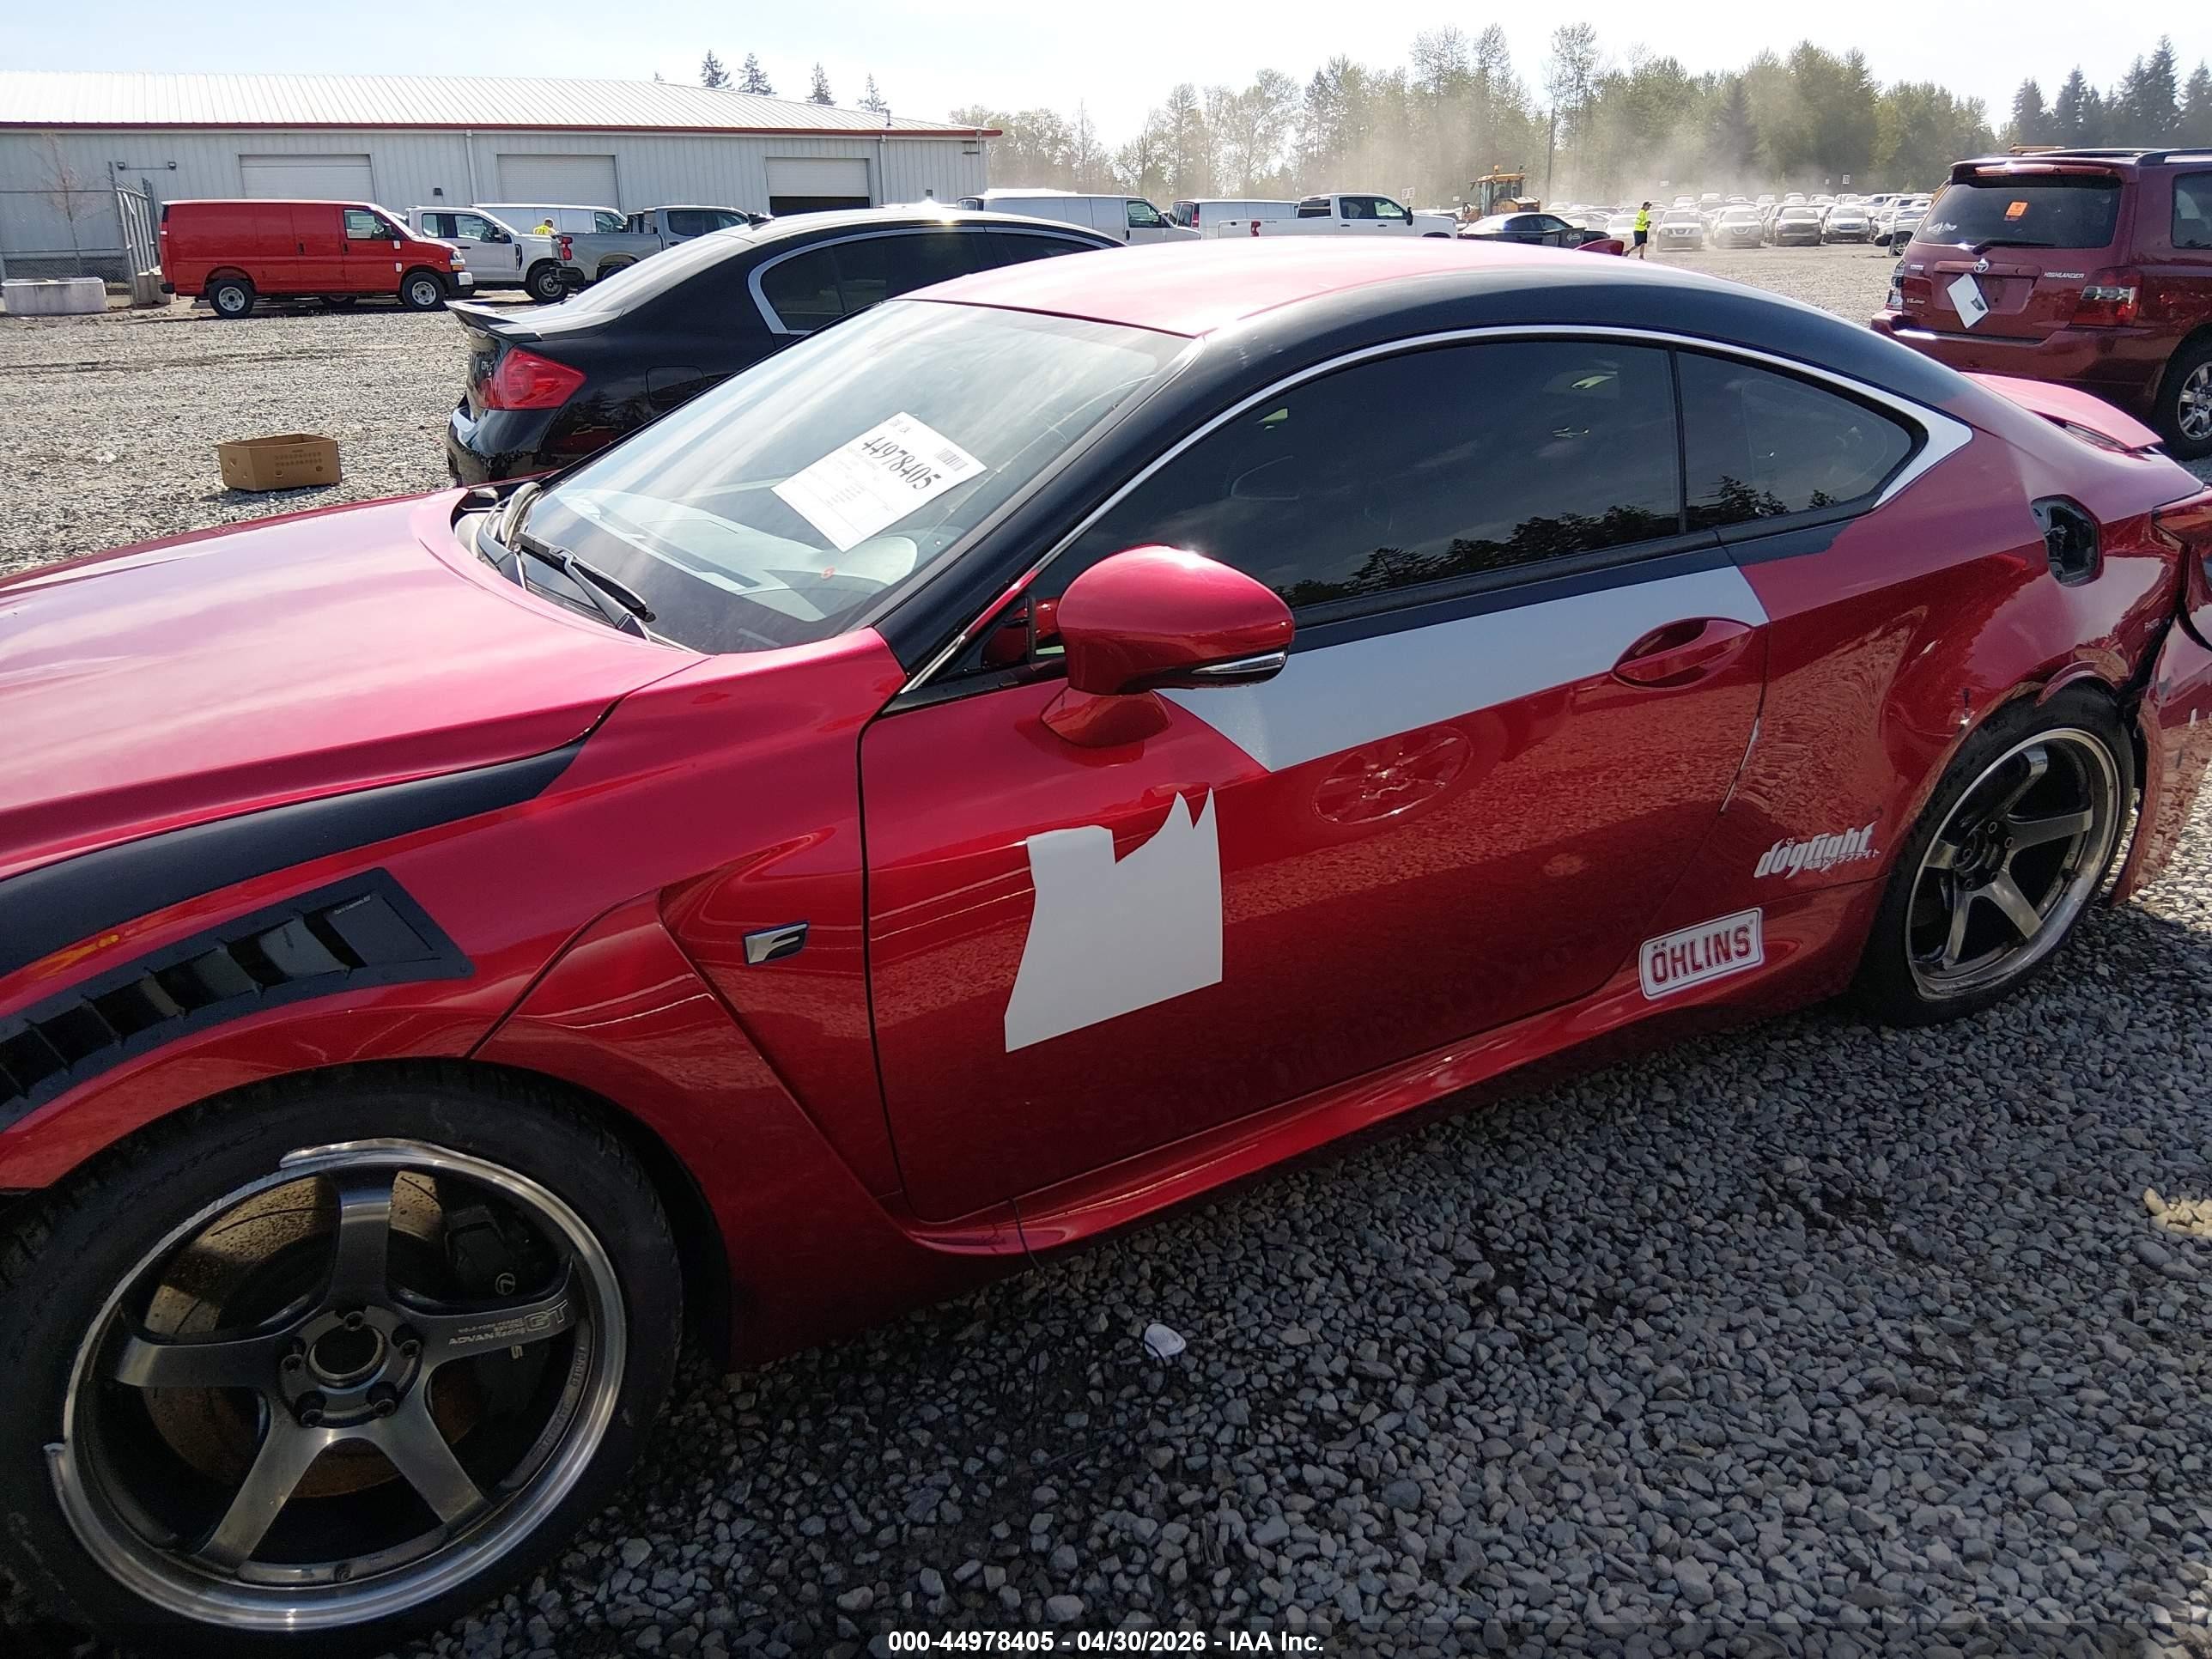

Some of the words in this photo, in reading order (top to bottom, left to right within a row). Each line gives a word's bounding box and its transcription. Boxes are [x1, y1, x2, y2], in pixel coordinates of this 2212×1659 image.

[862, 435, 942, 490] 44978405
[1753, 820, 1877, 879] dogfight
[1650, 926, 1751, 986] ÖHLINS
[448, 1332, 495, 1346] ADVAN
